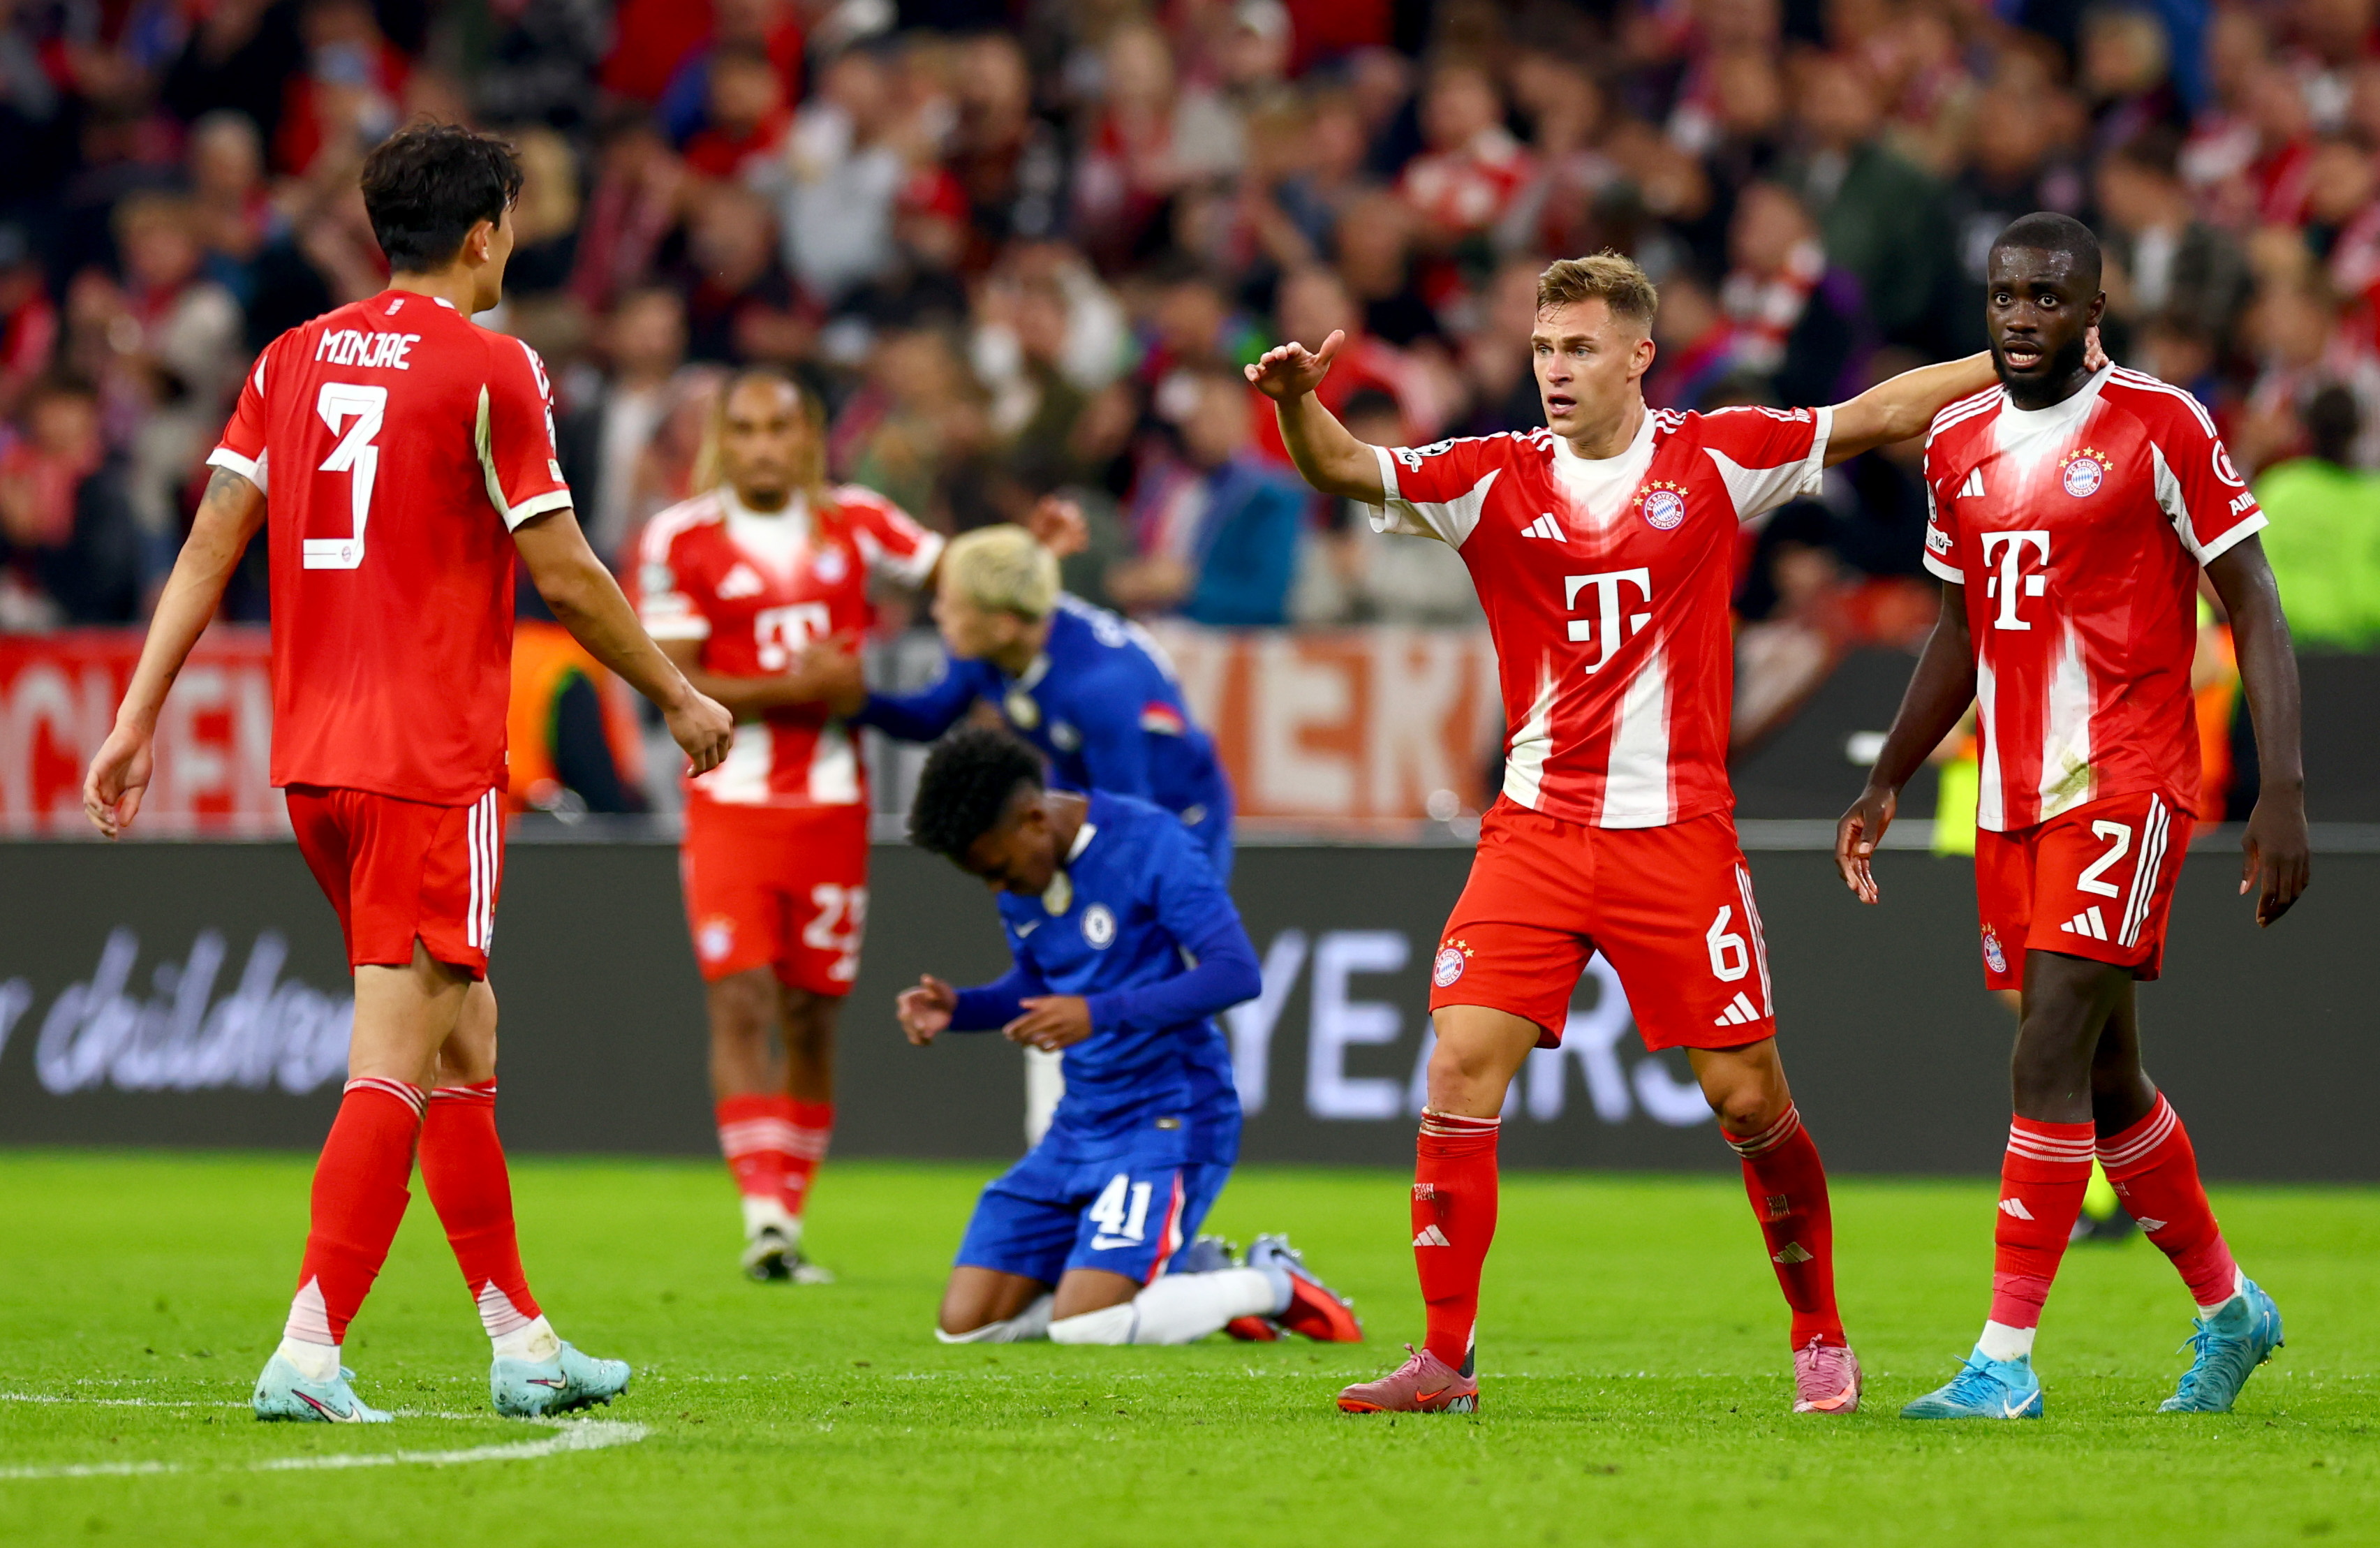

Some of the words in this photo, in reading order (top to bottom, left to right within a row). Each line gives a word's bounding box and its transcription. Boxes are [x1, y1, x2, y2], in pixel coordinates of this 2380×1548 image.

[315, 327, 422, 370] MINJAE
[303, 382, 389, 570] 3
[1652, 494, 1679, 505] BAYERN
[2077, 461, 2099, 477] BAYERN
[2077, 820, 2131, 898] 2
[1706, 904, 1750, 982] 6
[1223, 927, 1721, 1127] YER
[1088, 1172, 1153, 1241] 41
